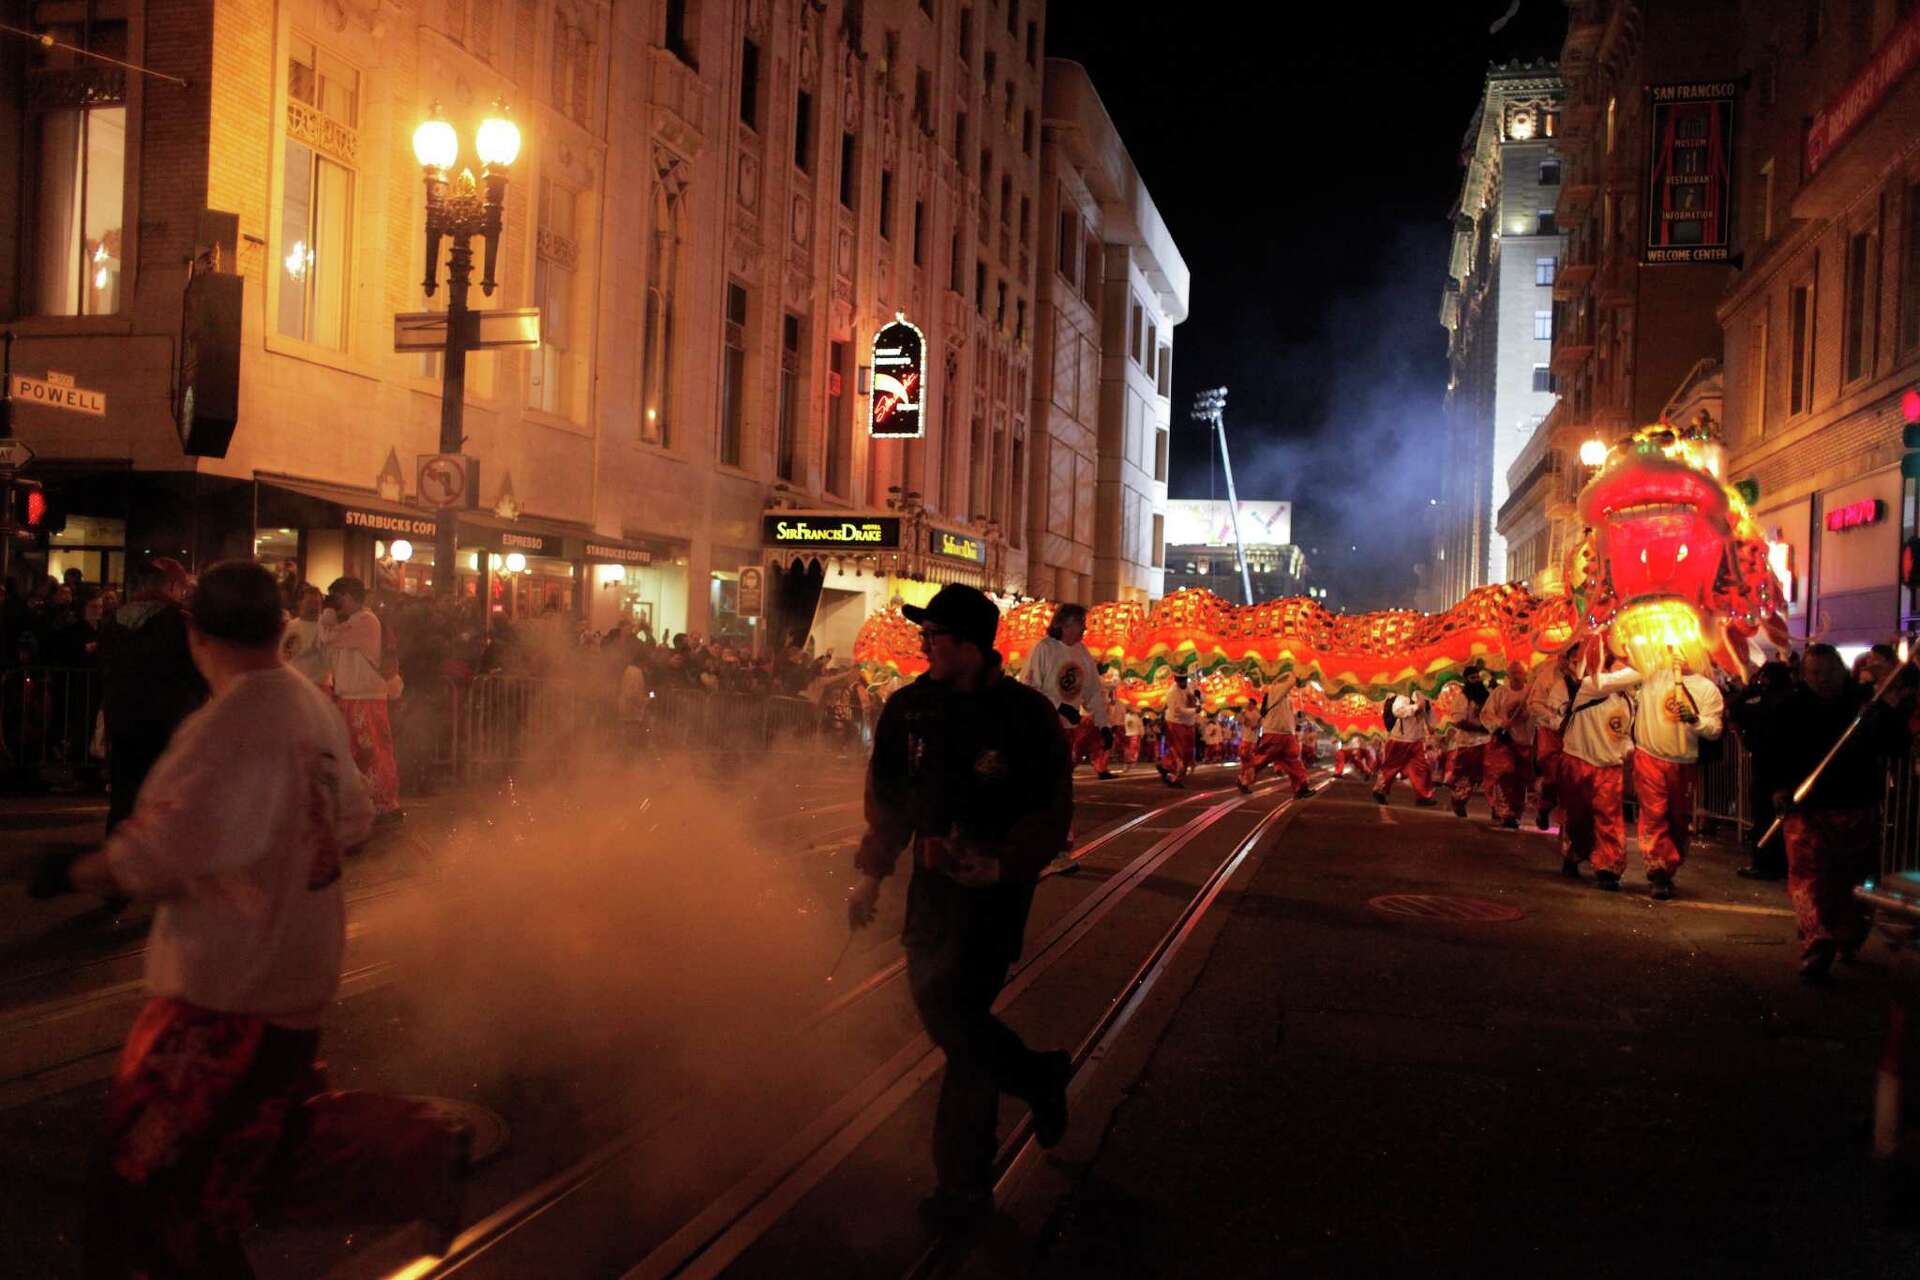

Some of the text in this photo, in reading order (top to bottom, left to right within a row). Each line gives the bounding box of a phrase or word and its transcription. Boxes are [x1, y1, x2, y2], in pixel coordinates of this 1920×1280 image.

[1653, 82, 1735, 100] SAN FRANCISCO
[1665, 175, 1713, 185] RESTAURANT
[1662, 210, 1713, 221] INFORMATION
[1647, 248, 1728, 262] WELCOME CENTER
[20, 381, 101, 411] POWELL
[345, 511, 411, 533] STARBUCKS
[502, 533, 543, 550] ESPRESSO
[586, 544, 651, 563] STARBUCKS COFFEE
